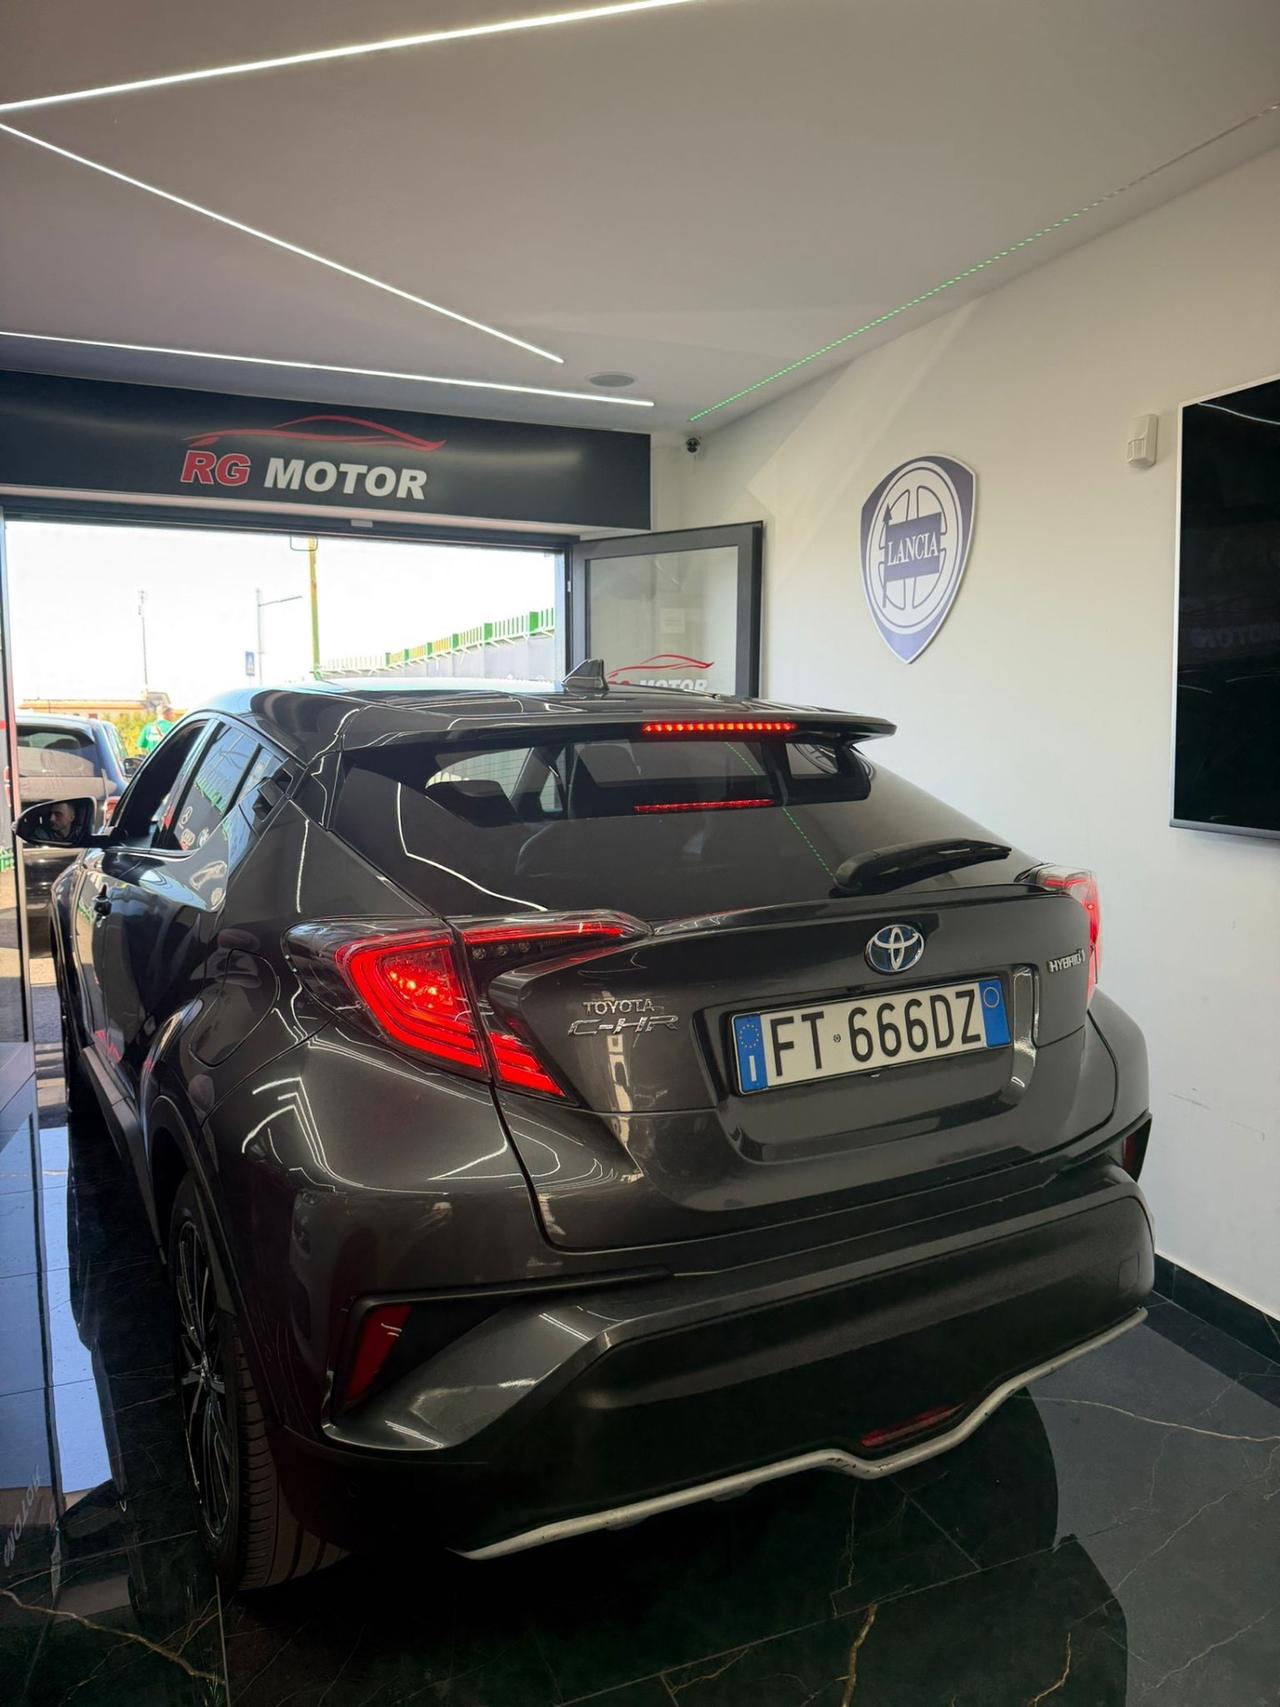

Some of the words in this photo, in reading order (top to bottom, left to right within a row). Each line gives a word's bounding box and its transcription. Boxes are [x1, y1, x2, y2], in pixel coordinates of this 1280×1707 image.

[180, 449, 251, 487] RG
[263, 457, 428, 500] MOTOR
[887, 531, 939, 567] LANCIA
[1049, 953, 1081, 973] HYBRID
[583, 999, 655, 1015] TOYOTA
[568, 1015, 679, 1035] C-HR
[770, 1011, 825, 1077] FT
[848, 989, 981, 1062] 666DZ
